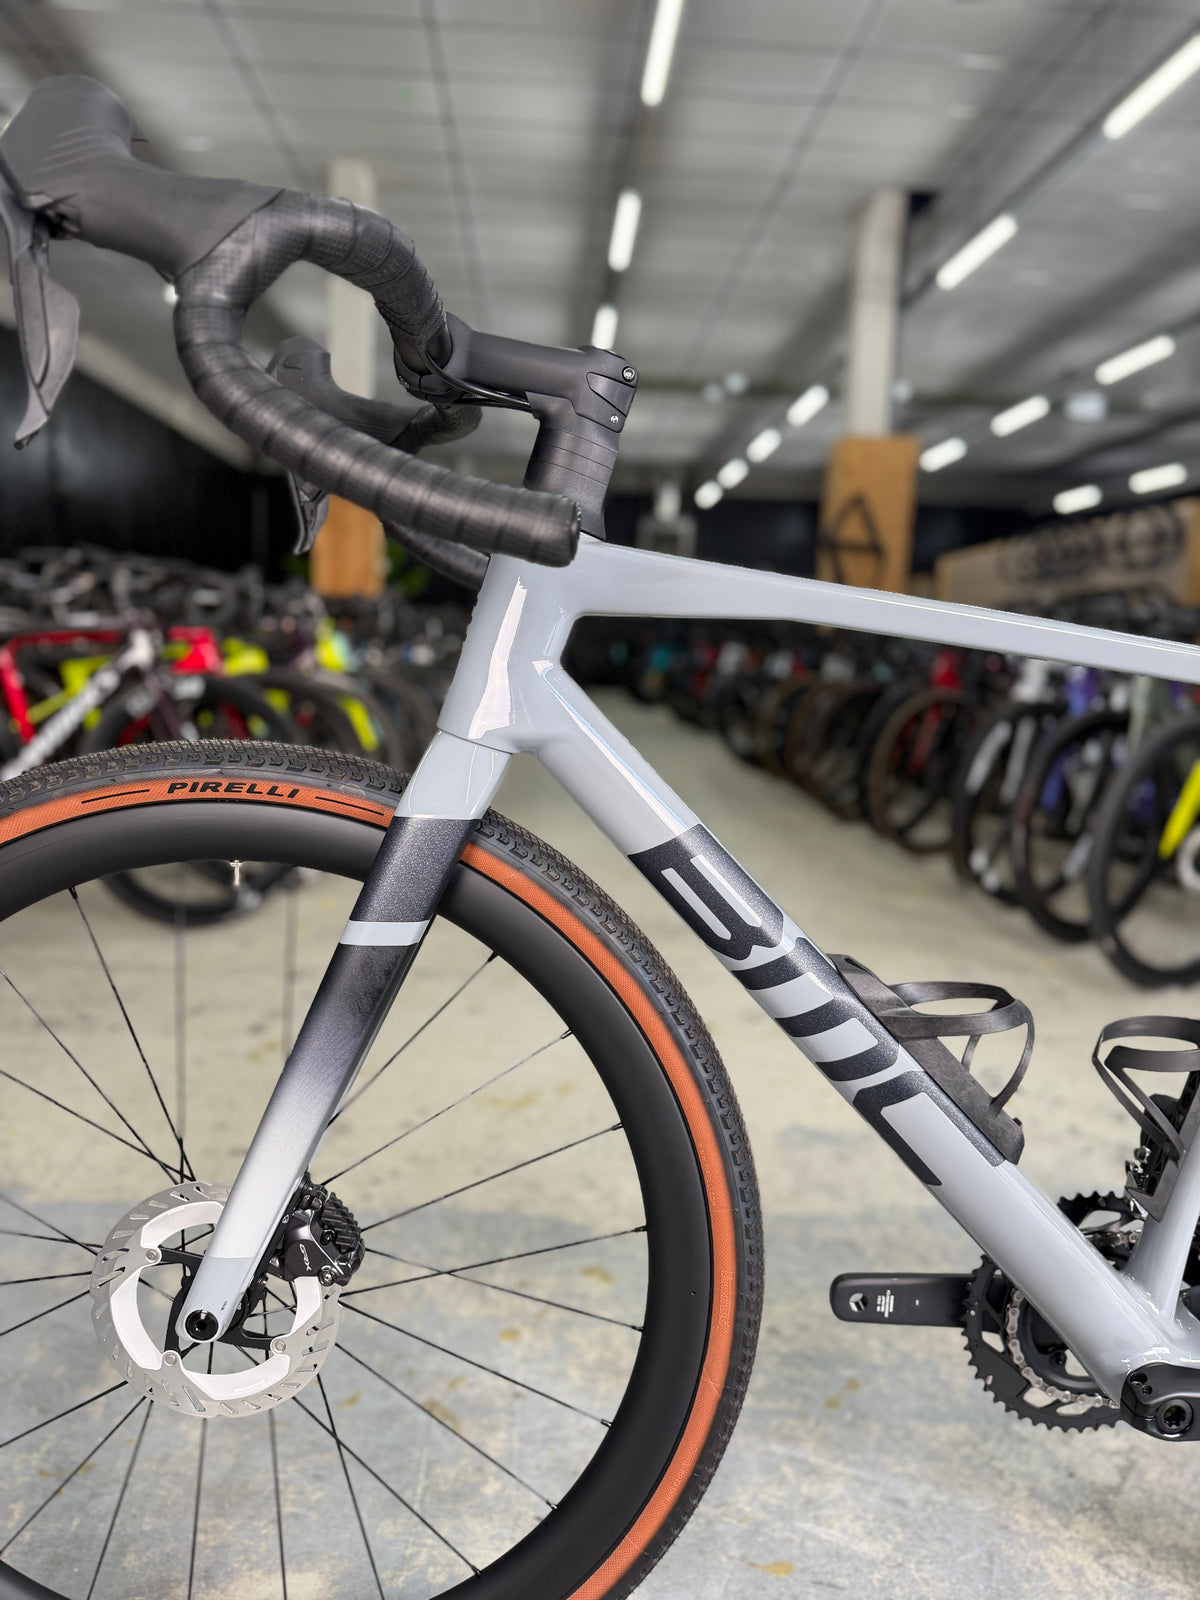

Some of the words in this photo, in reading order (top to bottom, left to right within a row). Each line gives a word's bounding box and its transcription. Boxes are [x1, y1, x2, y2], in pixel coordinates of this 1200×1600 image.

[167, 782, 300, 799] PIRELLI
[627, 823, 1006, 1186] BMC
[299, 1243, 312, 1271] GRX
